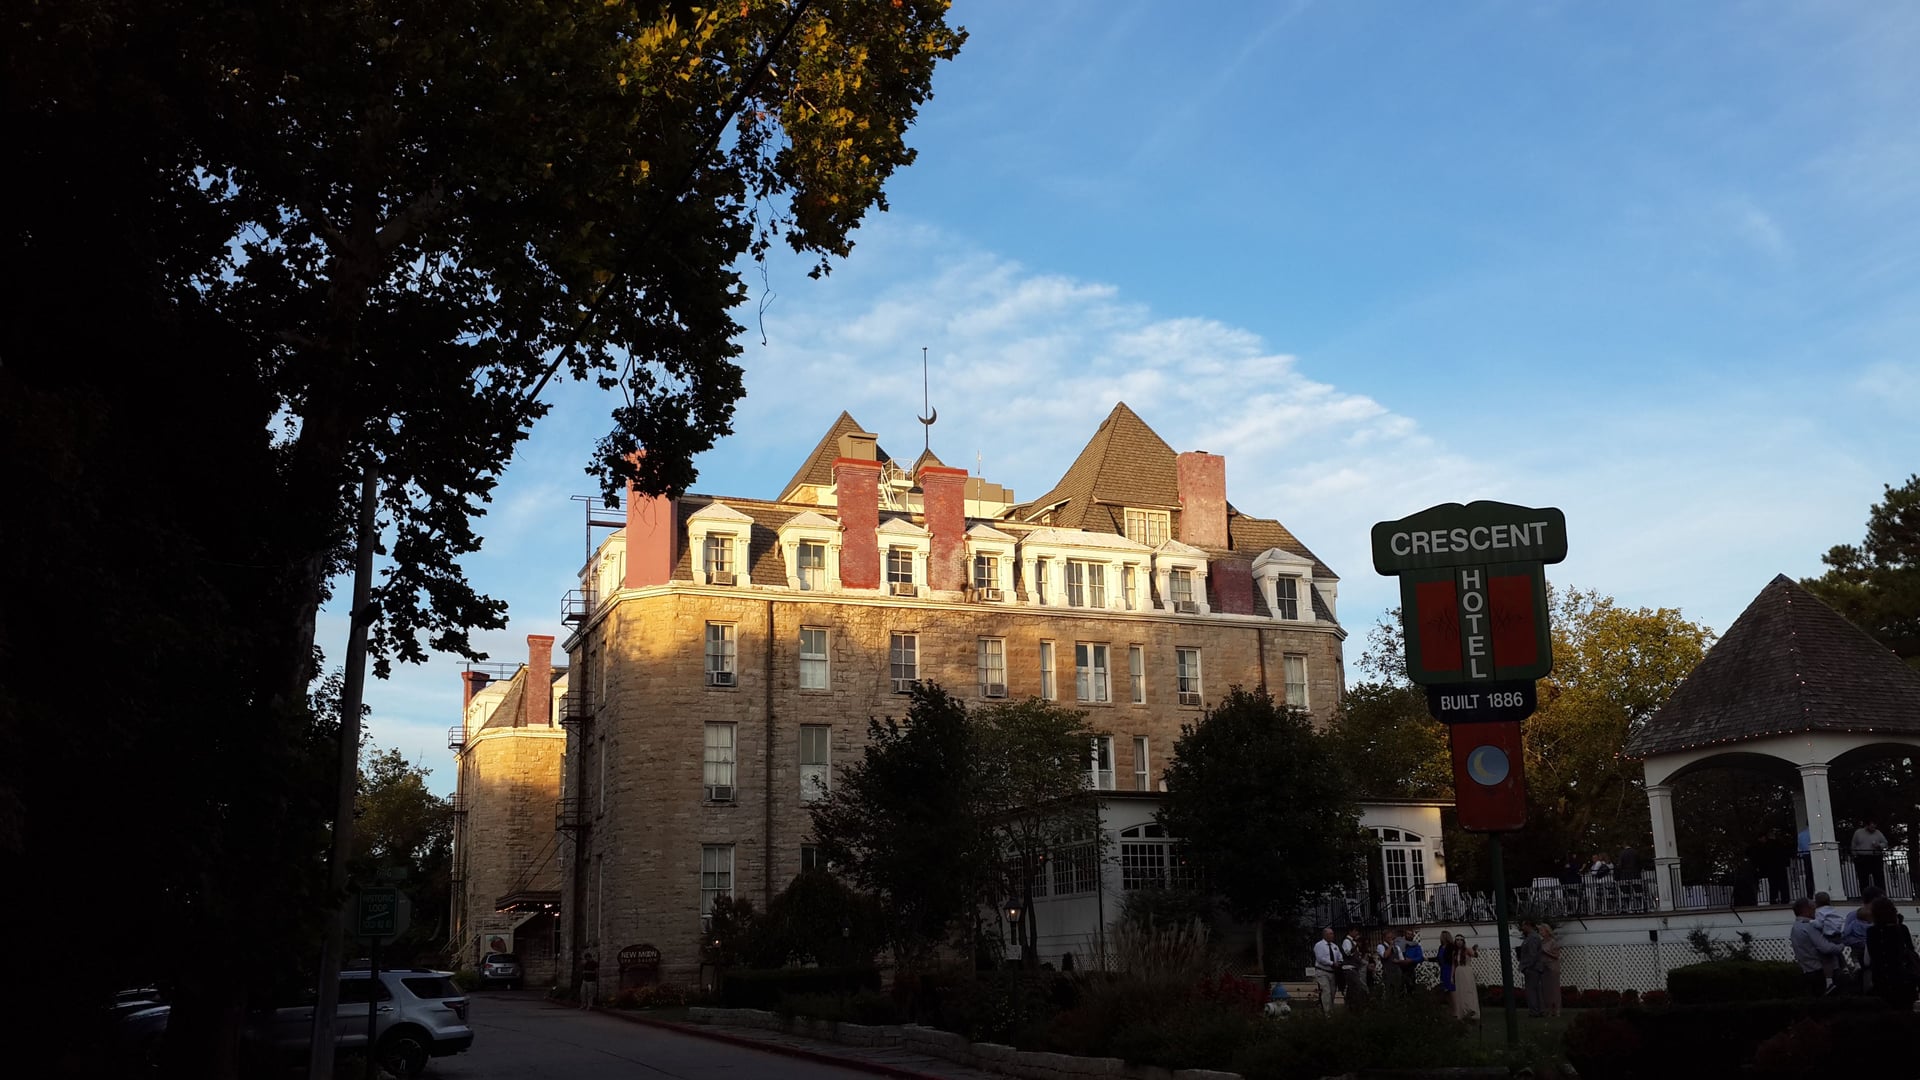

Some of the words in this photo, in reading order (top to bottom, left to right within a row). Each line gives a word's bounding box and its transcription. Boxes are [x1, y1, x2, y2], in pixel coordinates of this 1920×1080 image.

[1391, 522, 1548, 556] CRESCENT
[1461, 569, 1488, 680] HOTEL
[1440, 694, 1480, 711] BUILT
[1487, 692, 1524, 708] 1886
[621, 951, 637, 959] NEW
